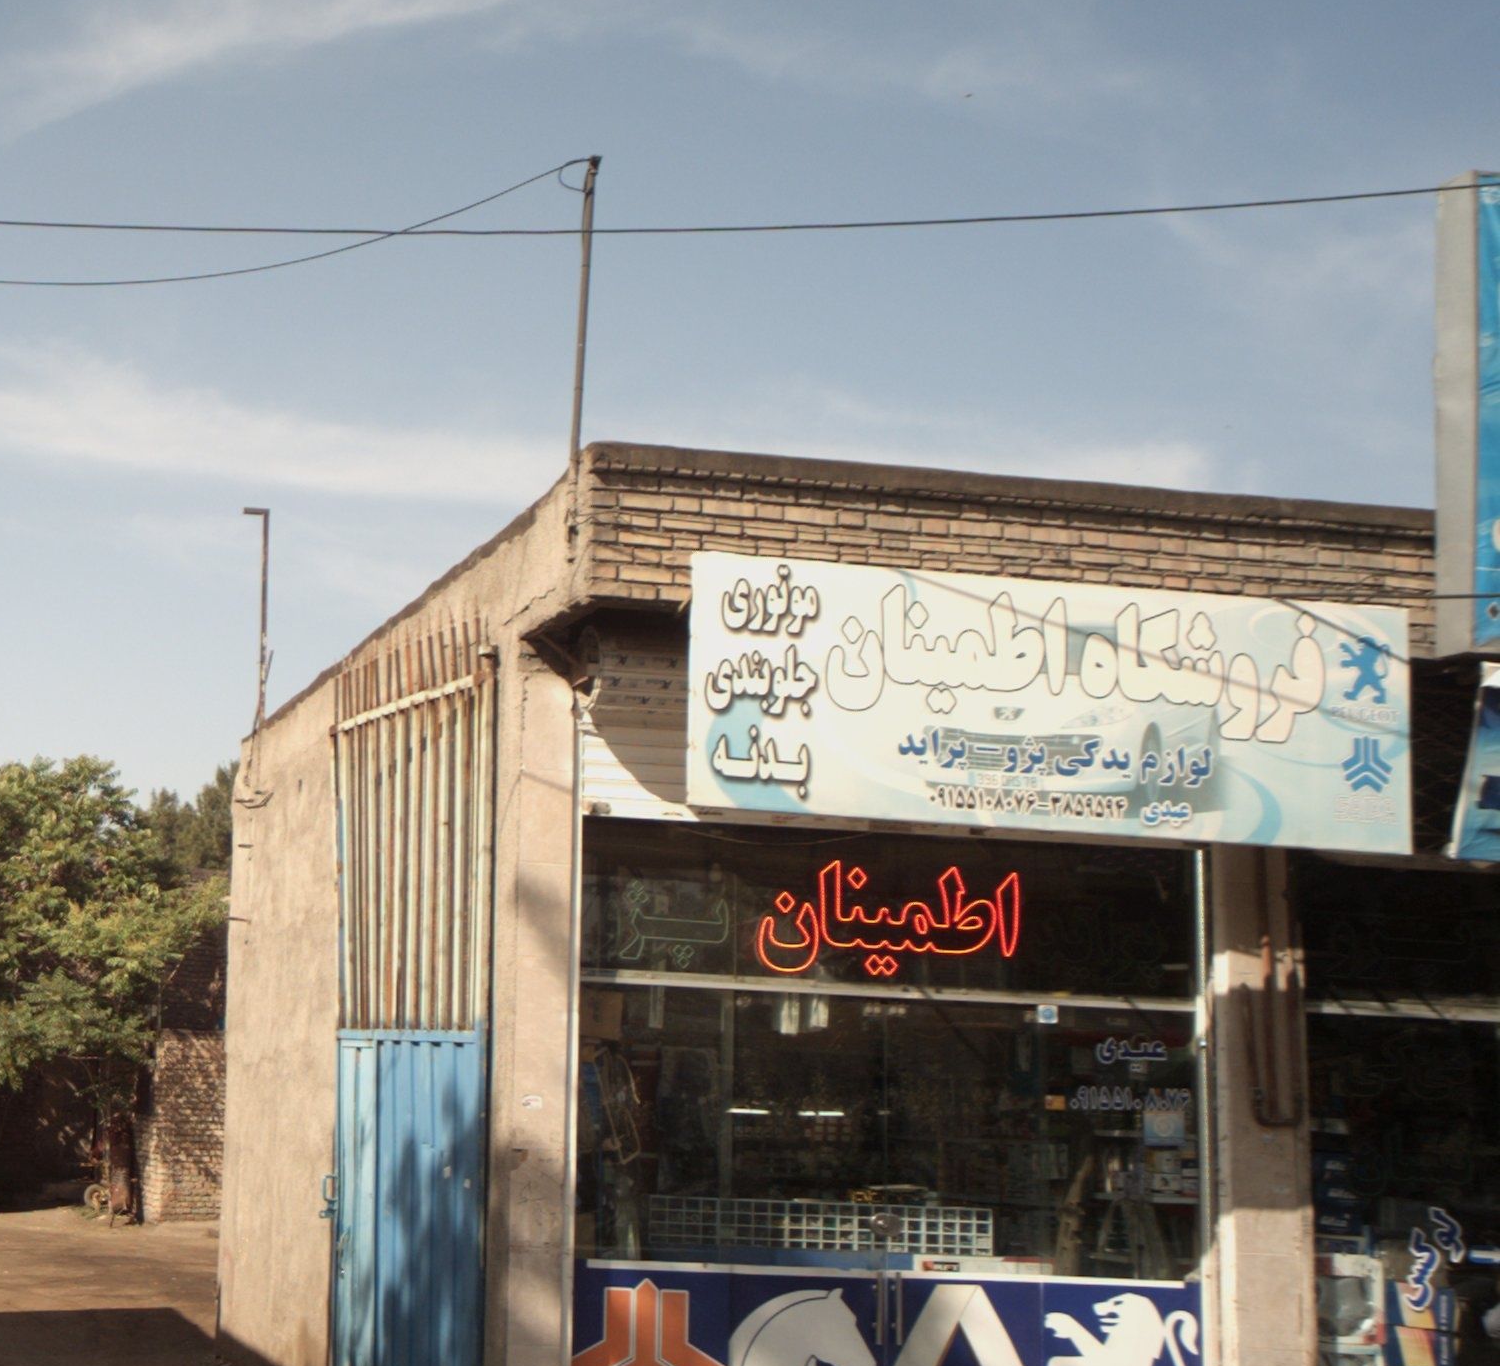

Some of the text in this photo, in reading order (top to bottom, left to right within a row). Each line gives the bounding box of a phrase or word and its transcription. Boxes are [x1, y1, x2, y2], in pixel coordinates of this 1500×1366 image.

[721, 564, 820, 636] موتوری
[704, 643, 819, 717] جلوبندی
[826, 584, 1325, 743] فروشگاه اطمینان
[711, 725, 811, 800] بدنه
[898, 729, 968, 769] پراید
[1055, 738, 1131, 779] یدکی
[1140, 746, 1213, 786] لوازم
[1141, 801, 1192, 827] عیدی
[757, 860, 1020, 976] اطمینان
[1096, 1037, 1168, 1072] عیدی
